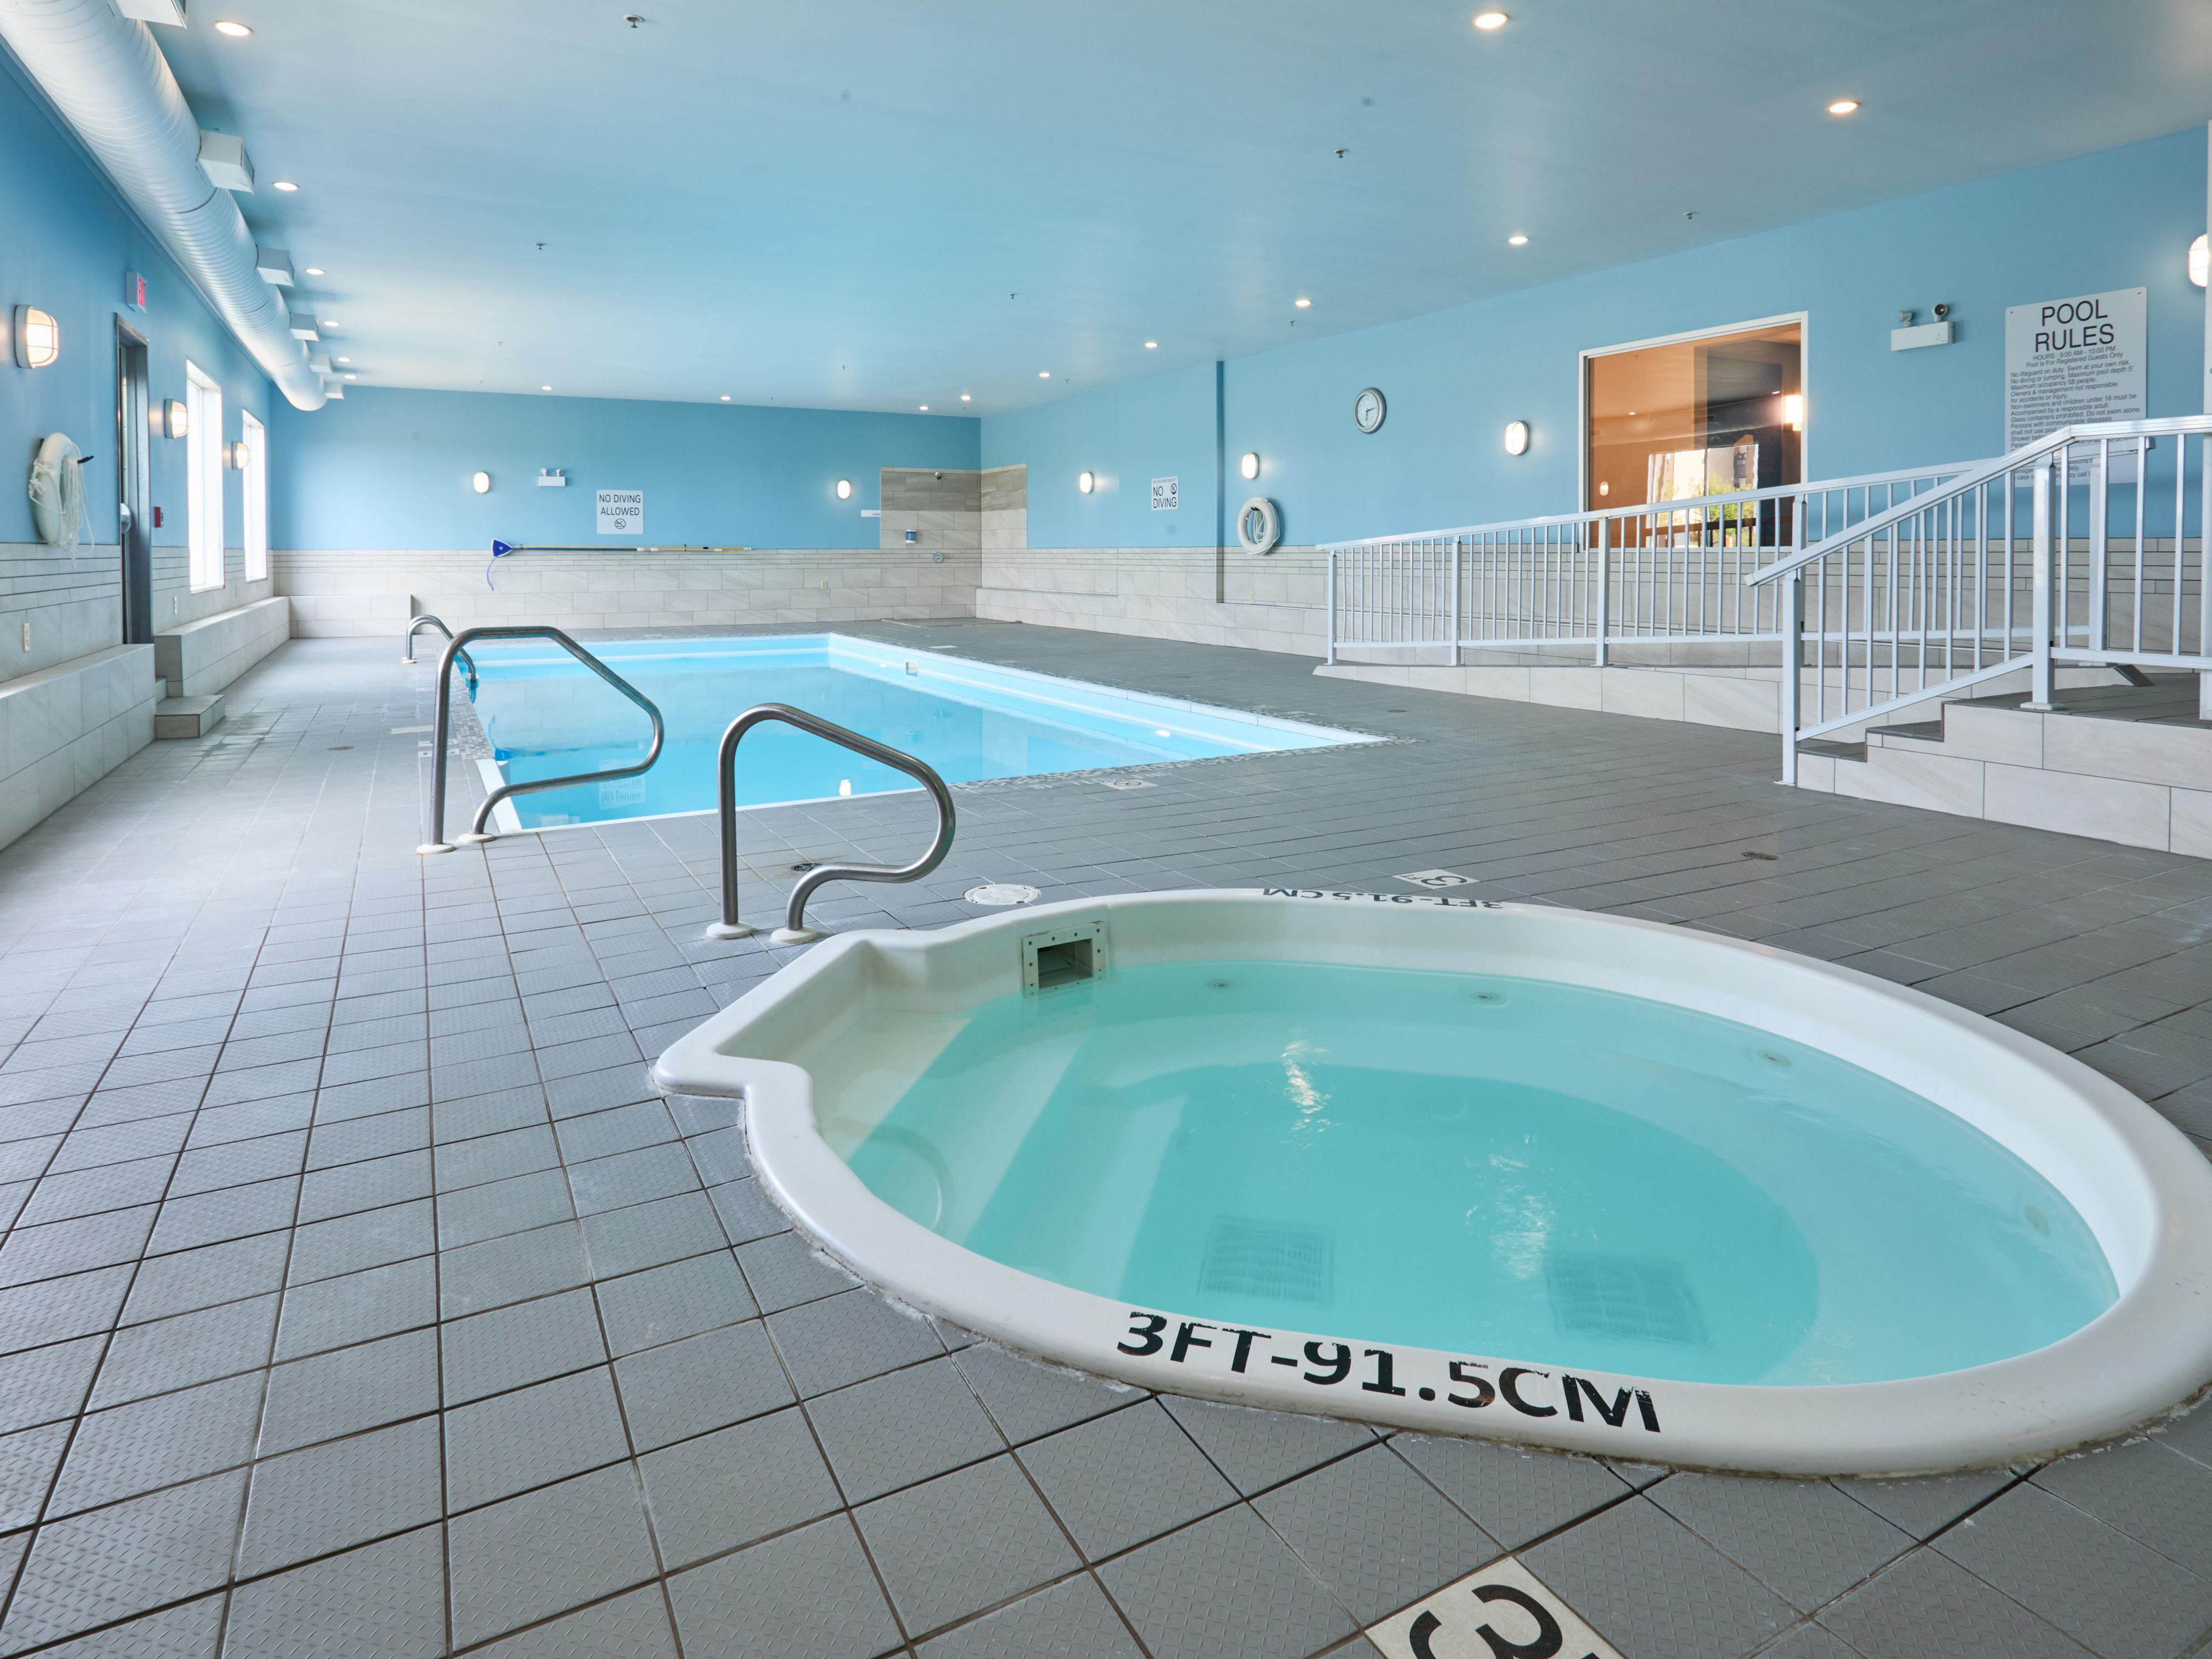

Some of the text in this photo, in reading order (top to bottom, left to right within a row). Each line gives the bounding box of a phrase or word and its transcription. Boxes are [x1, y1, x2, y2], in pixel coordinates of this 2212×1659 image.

[2042, 299, 2108, 326] POOL
[2036, 324, 2114, 352] RULES
[2056, 356, 2086, 365] Registered
[1153, 486, 1164, 497] NO
[599, 494, 641, 503] NO DIVING
[1153, 497, 1177, 508] DIVING
[601, 507, 640, 515] ALLOWED
[1117, 1311, 1661, 1433] 3FT-91.5CM
